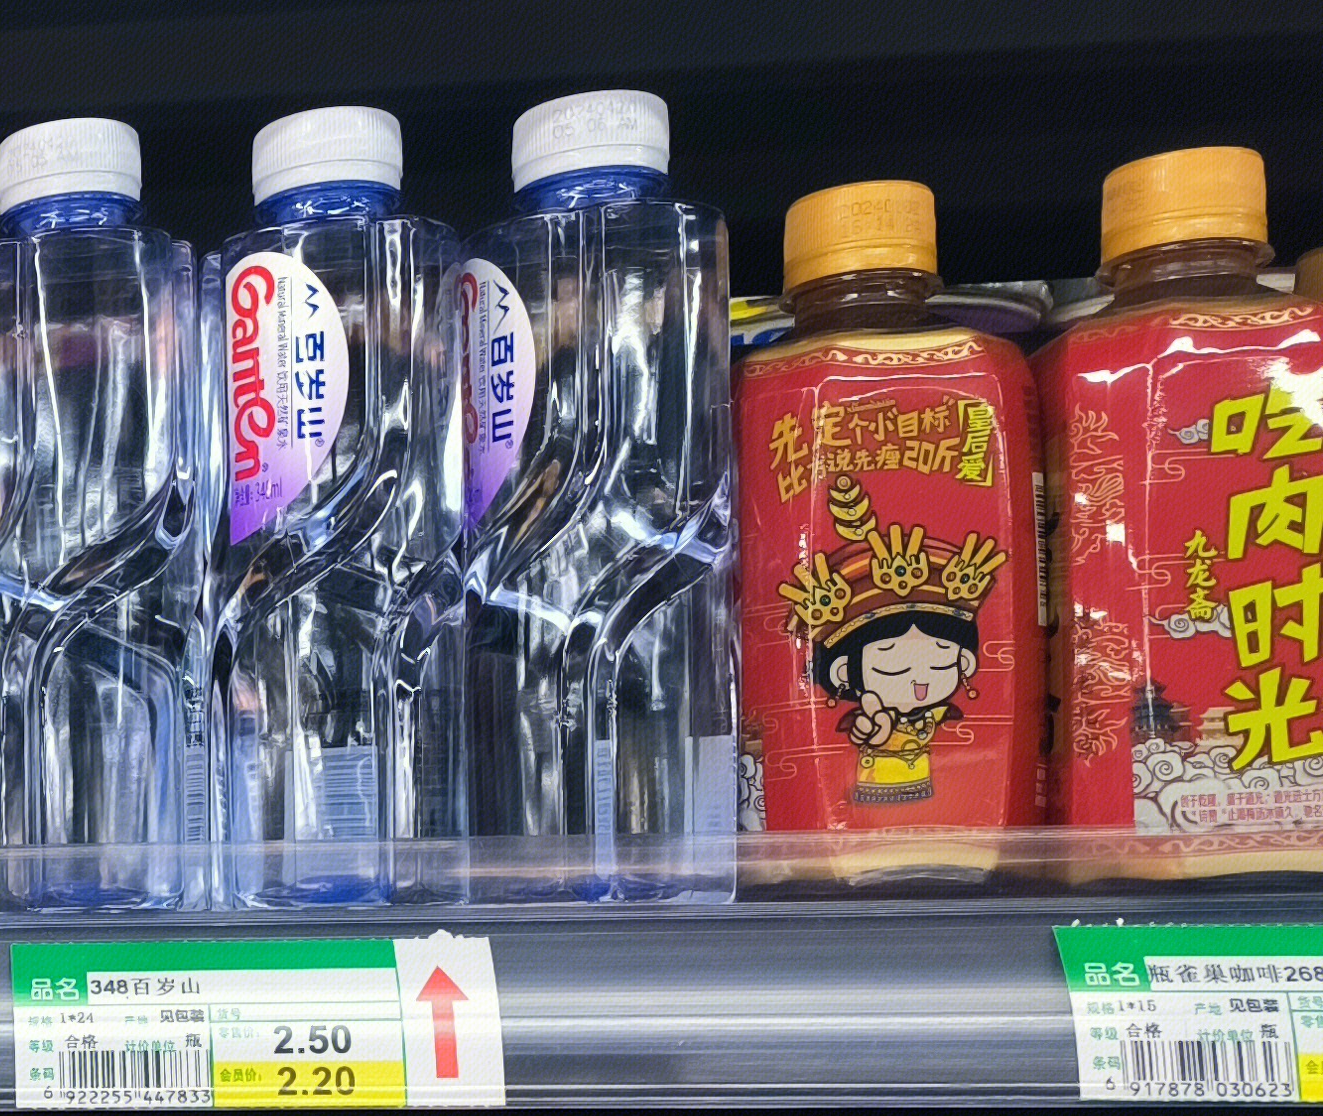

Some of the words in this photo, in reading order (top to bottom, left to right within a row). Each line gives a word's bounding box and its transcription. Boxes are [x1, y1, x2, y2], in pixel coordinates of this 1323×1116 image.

[295, 331, 325, 440] 百岁山
[491, 332, 514, 443] 百岁山
[1084, 961, 1140, 987] 品名
[30, 977, 81, 1001] 品名
[89, 977, 201, 997] 348百岁山
[159, 1008, 205, 1023] 见包装
[1229, 998, 1280, 1014] 见包装
[273, 1024, 352, 1055] 2.50
[1125, 1022, 1163, 1039] 合格
[1260, 1023, 1279, 1040] 瓶
[28, 1038, 54, 1053] 等级
[65, 1034, 97, 1050] 合格
[185, 1033, 203, 1049] 瓶
[277, 1065, 356, 1096] 2.20
[1129, 1081, 1205, 1097] 917878
[1216, 1081, 1293, 1098] 030623
[66, 1088, 132, 1105] 922255
[142, 1088, 211, 1105] 447833
